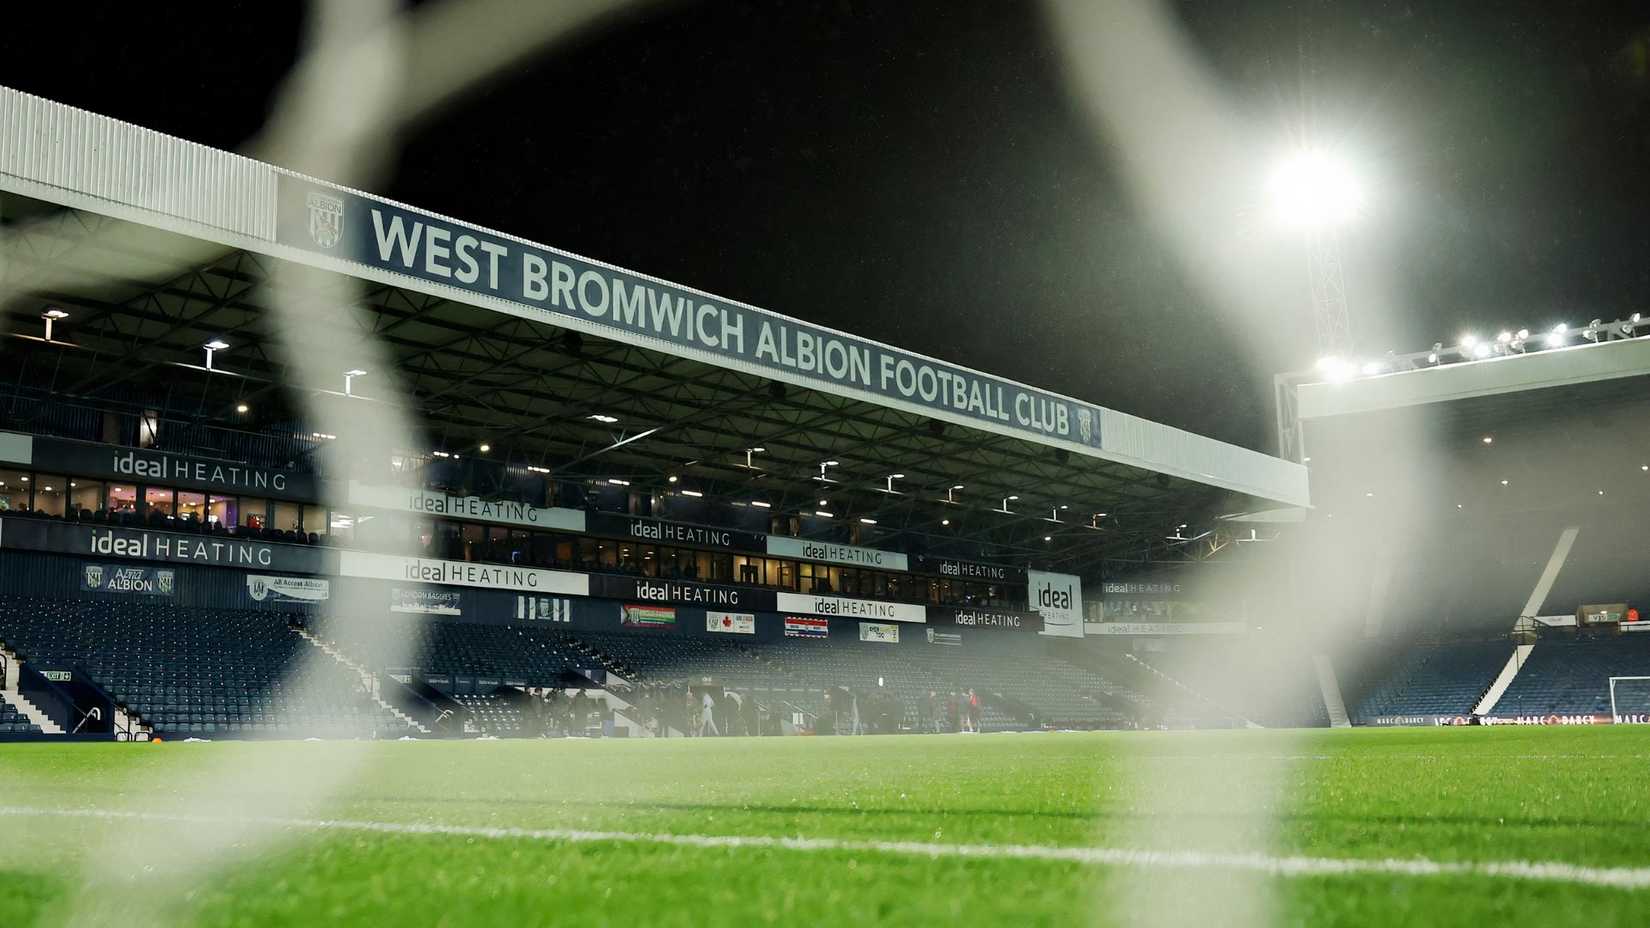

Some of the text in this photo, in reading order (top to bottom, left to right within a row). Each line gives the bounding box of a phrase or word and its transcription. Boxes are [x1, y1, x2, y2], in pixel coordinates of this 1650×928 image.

[371, 208, 1070, 436] WEST BROMWICH ALBION FOOTBALL CLUB
[113, 451, 286, 490] ideal HEATING
[409, 494, 538, 522] ideal HEATING
[630, 519, 730, 546] ideal HEATING
[91, 530, 272, 566] ideal HEATING
[802, 544, 882, 565] ideal HEATING
[405, 560, 538, 587] ideal HEATING
[939, 563, 1004, 579] ideal HEATING
[107, 579, 153, 591] ALBION
[636, 580, 738, 605] ideal HEATING
[1038, 581, 1073, 610] ideal
[1105, 584, 1128, 593] ideal
[814, 598, 895, 617] ideal HEATING
[955, 611, 1020, 627] ideal HEATING
[1517, 715, 1595, 725] MARC DARCY
[1614, 714, 1645, 724] MARC
